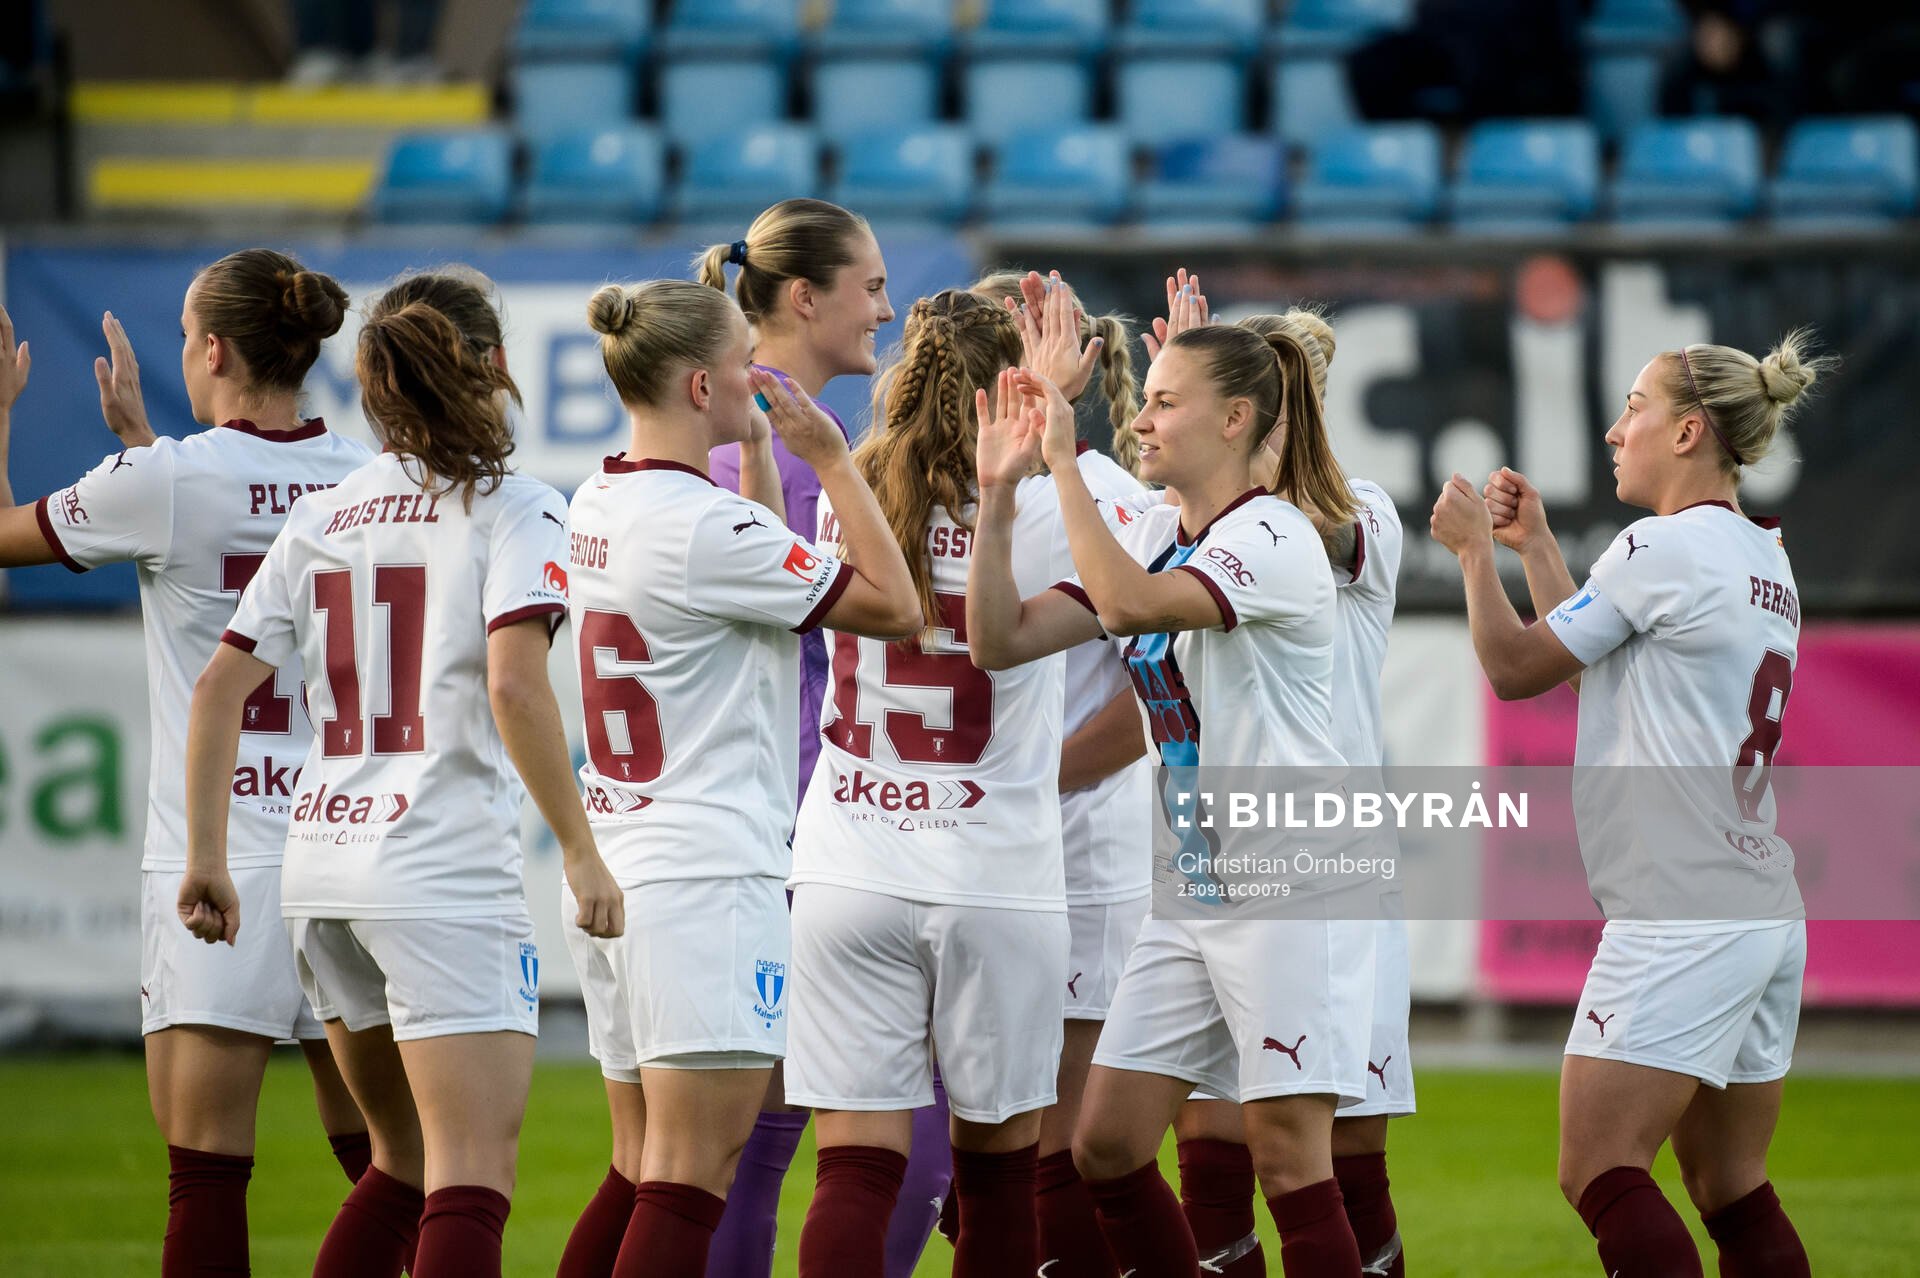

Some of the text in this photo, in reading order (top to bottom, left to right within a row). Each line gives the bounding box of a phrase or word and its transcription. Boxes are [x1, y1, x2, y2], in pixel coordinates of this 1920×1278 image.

[324, 494, 440, 535] KRISTELL
[570, 532, 608, 569] SKOOG
[806, 566, 832, 603] SVENSKA
[1749, 575, 1798, 628] PERSSON
[312, 563, 427, 760] 11
[821, 590, 995, 766] 15
[579, 606, 667, 783] 6
[1732, 647, 1793, 823] 8
[232, 756, 303, 796] ak
[833, 770, 930, 811] akea
[294, 783, 373, 824] akea
[851, 813, 875, 822] PART
[919, 820, 959, 829] ELEDA
